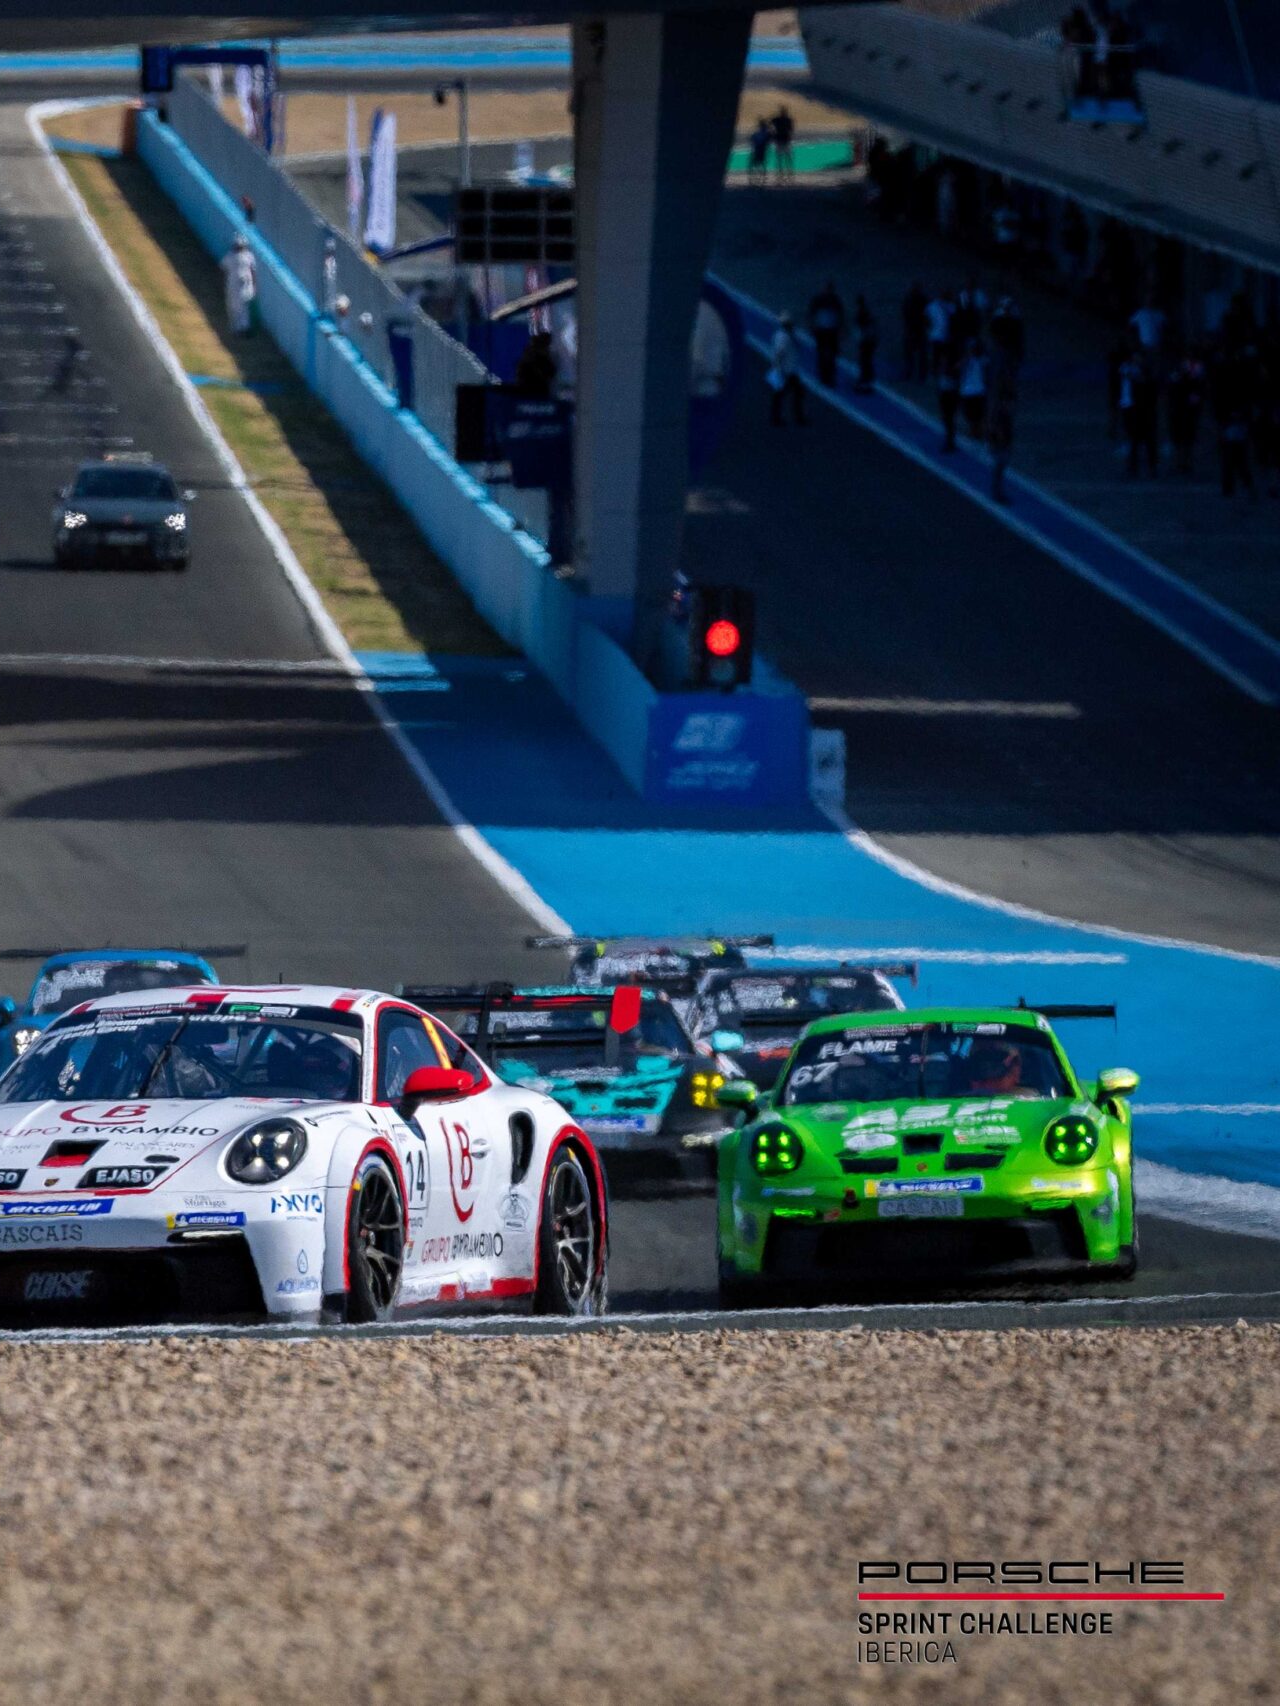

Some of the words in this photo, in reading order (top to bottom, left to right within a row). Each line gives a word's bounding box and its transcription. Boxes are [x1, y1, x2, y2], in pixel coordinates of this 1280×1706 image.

[821, 1039, 898, 1059] FLAME
[792, 1062, 839, 1088] 67
[95, 1168, 155, 1183] EJASO
[405, 1150, 426, 1201] 14
[7, 1202, 102, 1214] MICHELIN
